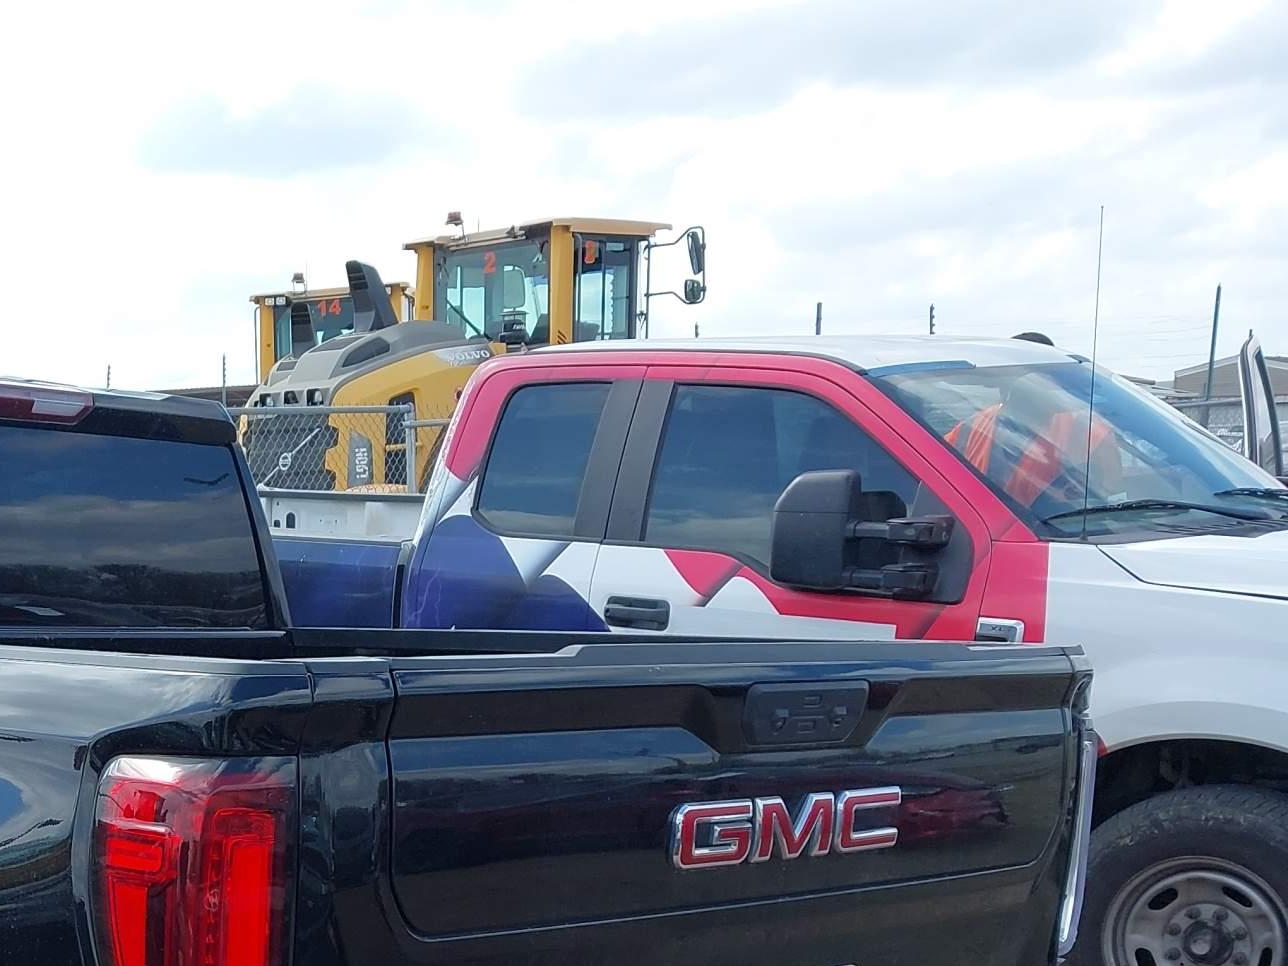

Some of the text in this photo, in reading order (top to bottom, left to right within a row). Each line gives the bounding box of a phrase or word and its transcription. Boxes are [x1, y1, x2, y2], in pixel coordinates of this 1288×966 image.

[483, 251, 496, 273] 2
[318, 297, 342, 317] 14
[449, 349, 491, 362] VOLVO
[669, 786, 902, 870] GMC
